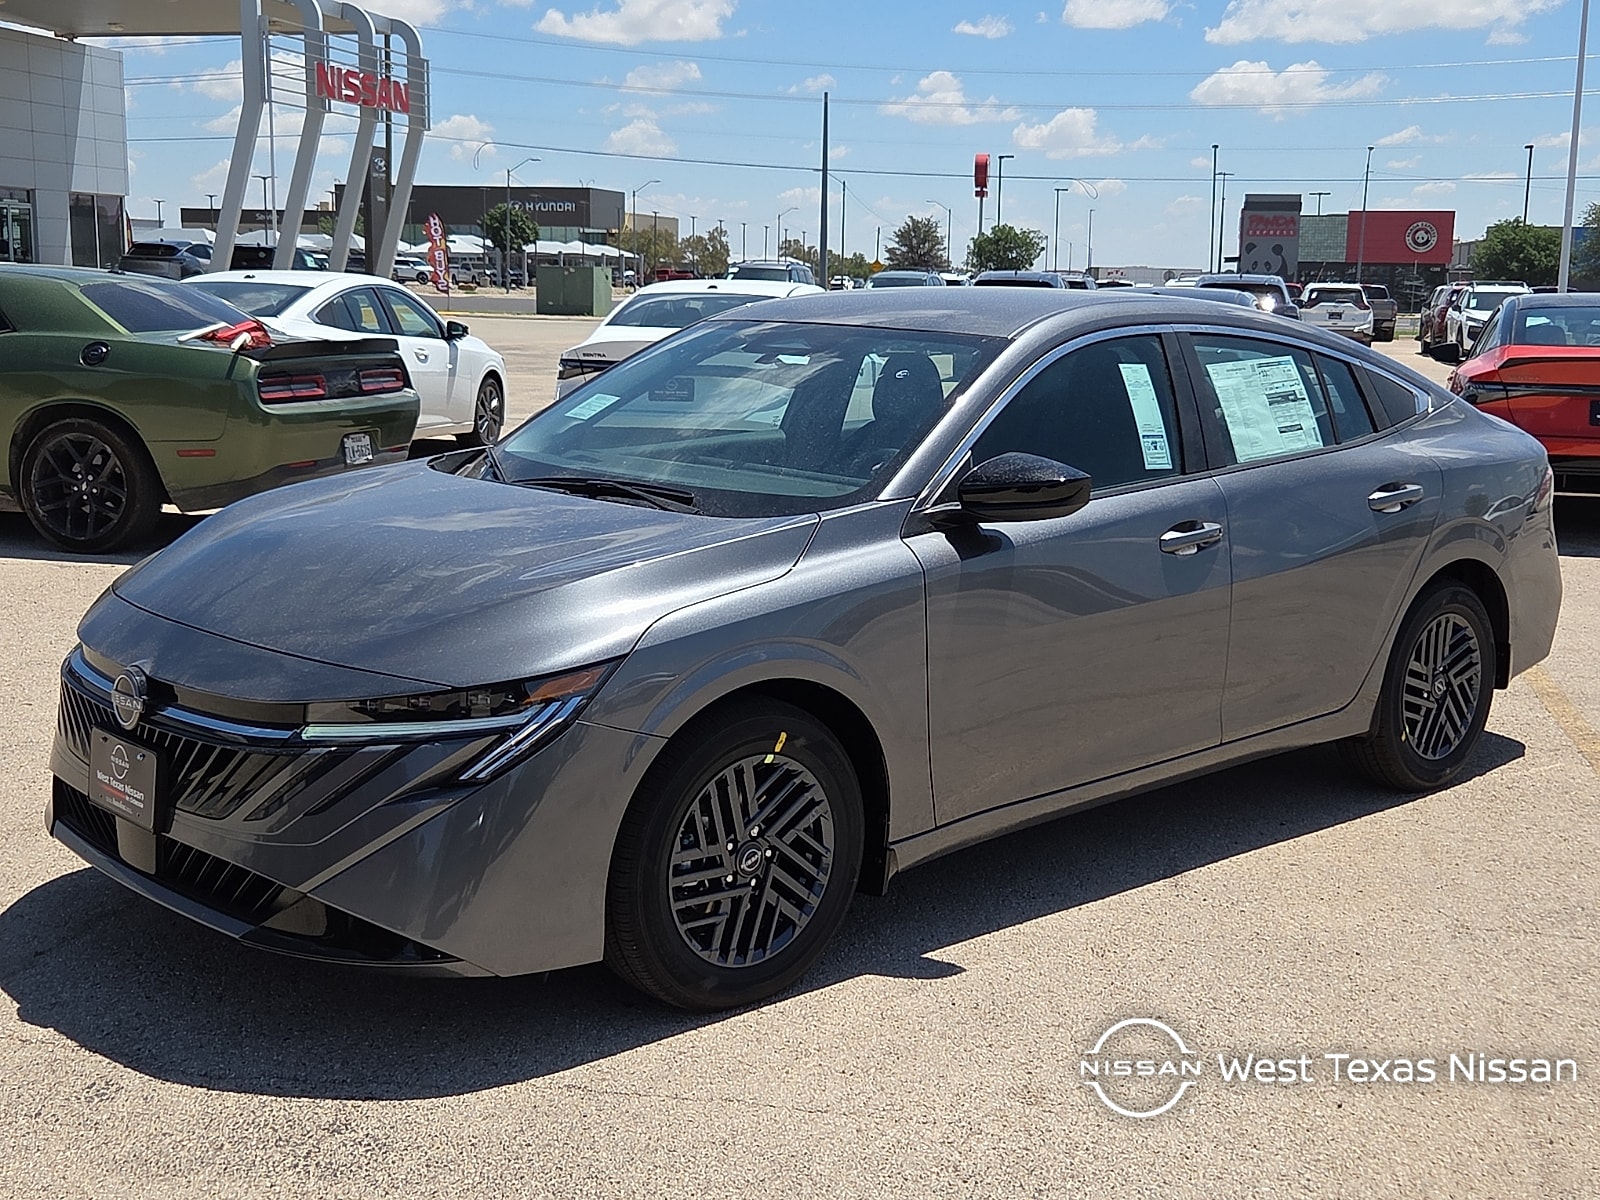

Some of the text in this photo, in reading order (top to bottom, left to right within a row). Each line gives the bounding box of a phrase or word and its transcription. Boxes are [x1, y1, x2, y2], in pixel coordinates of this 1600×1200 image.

[314, 61, 411, 114] NISSAN
[525, 201, 576, 213] HYUNDAI
[1248, 214, 1297, 228] PANDA
[429, 213, 450, 291] HOT BUYS
[96, 769, 145, 801] West Texas Nissan
